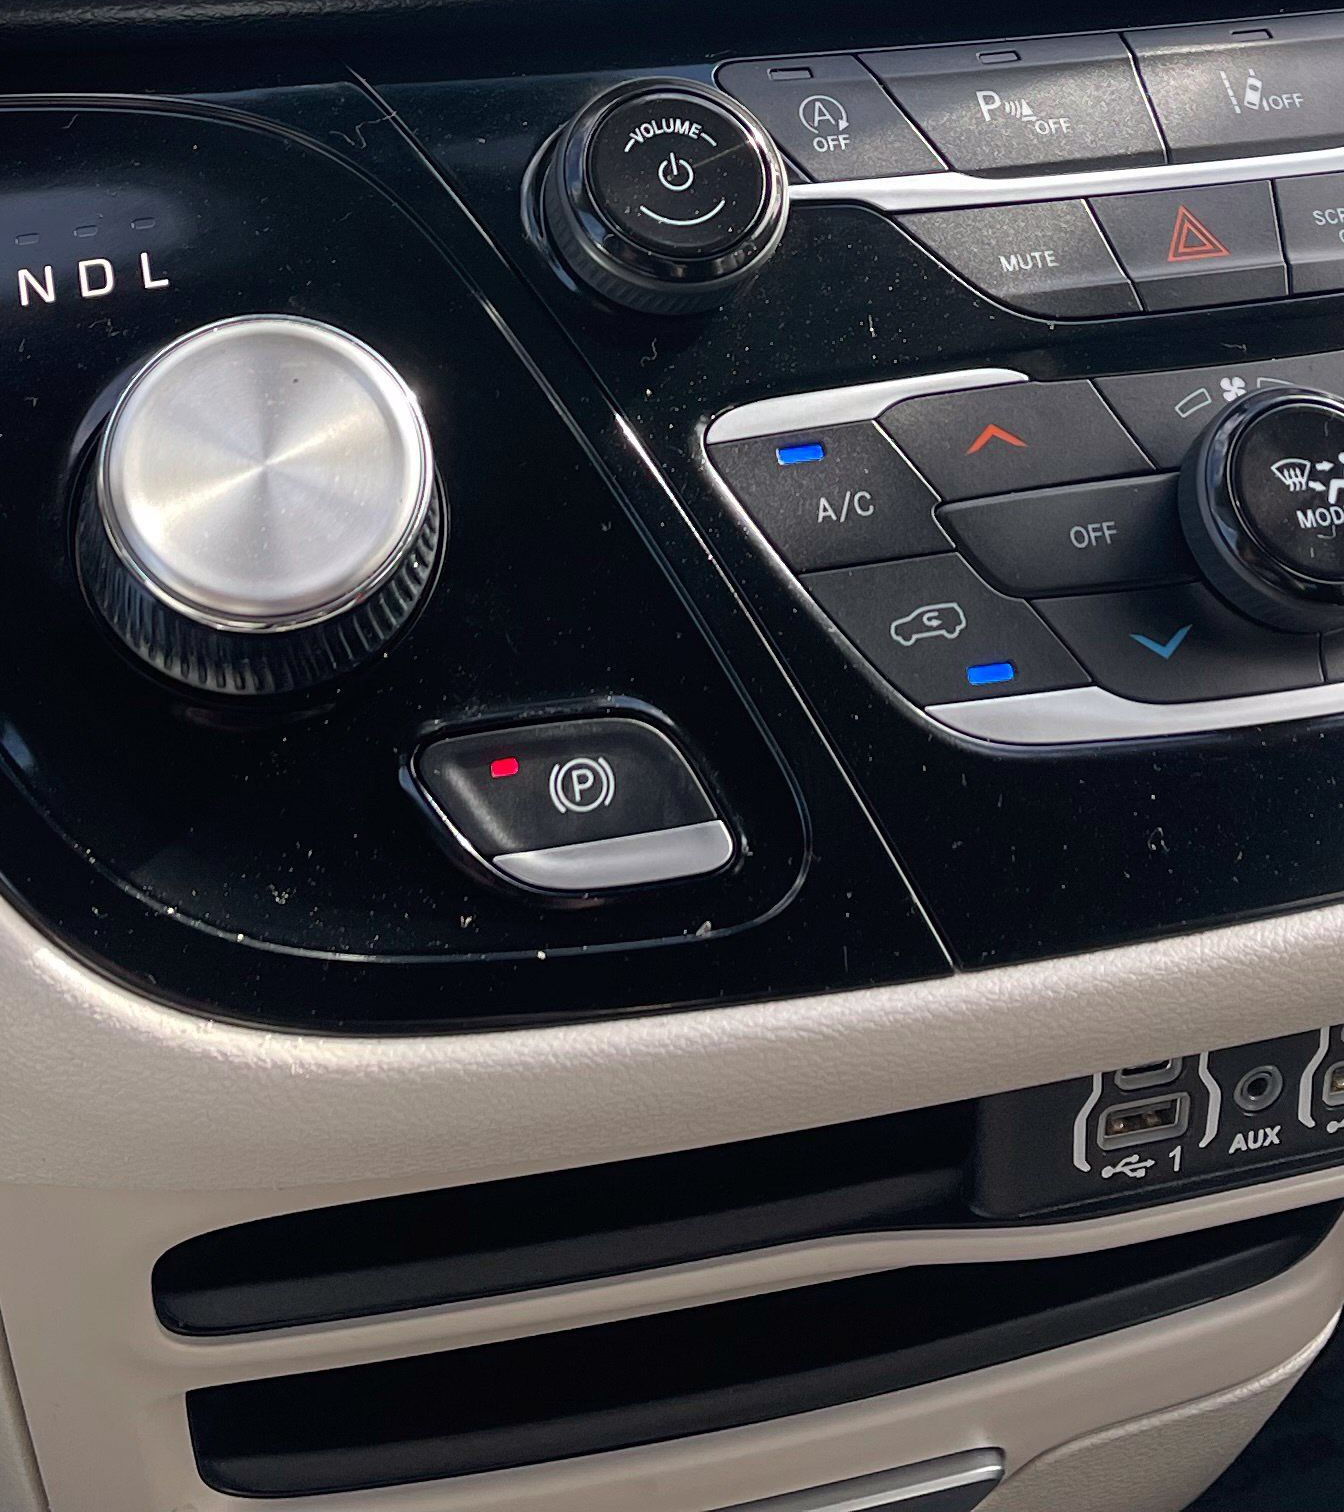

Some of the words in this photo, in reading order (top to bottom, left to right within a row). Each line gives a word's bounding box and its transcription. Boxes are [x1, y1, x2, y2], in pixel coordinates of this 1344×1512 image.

[974, 89, 1001, 123] P
[1033, 113, 1072, 136] OFF
[1268, 92, 1305, 111] OFF
[628, 117, 702, 144] VOLUME
[812, 134, 851, 153] OFF
[998, 250, 1058, 273] MUTE
[17, 265, 56, 306] N
[78, 258, 114, 298] D
[140, 252, 169, 289] L
[817, 490, 874, 523] A/C
[1069, 521, 1117, 549] OFF
[570, 768, 594, 802] P
[1228, 1125, 1281, 1154] AUX
